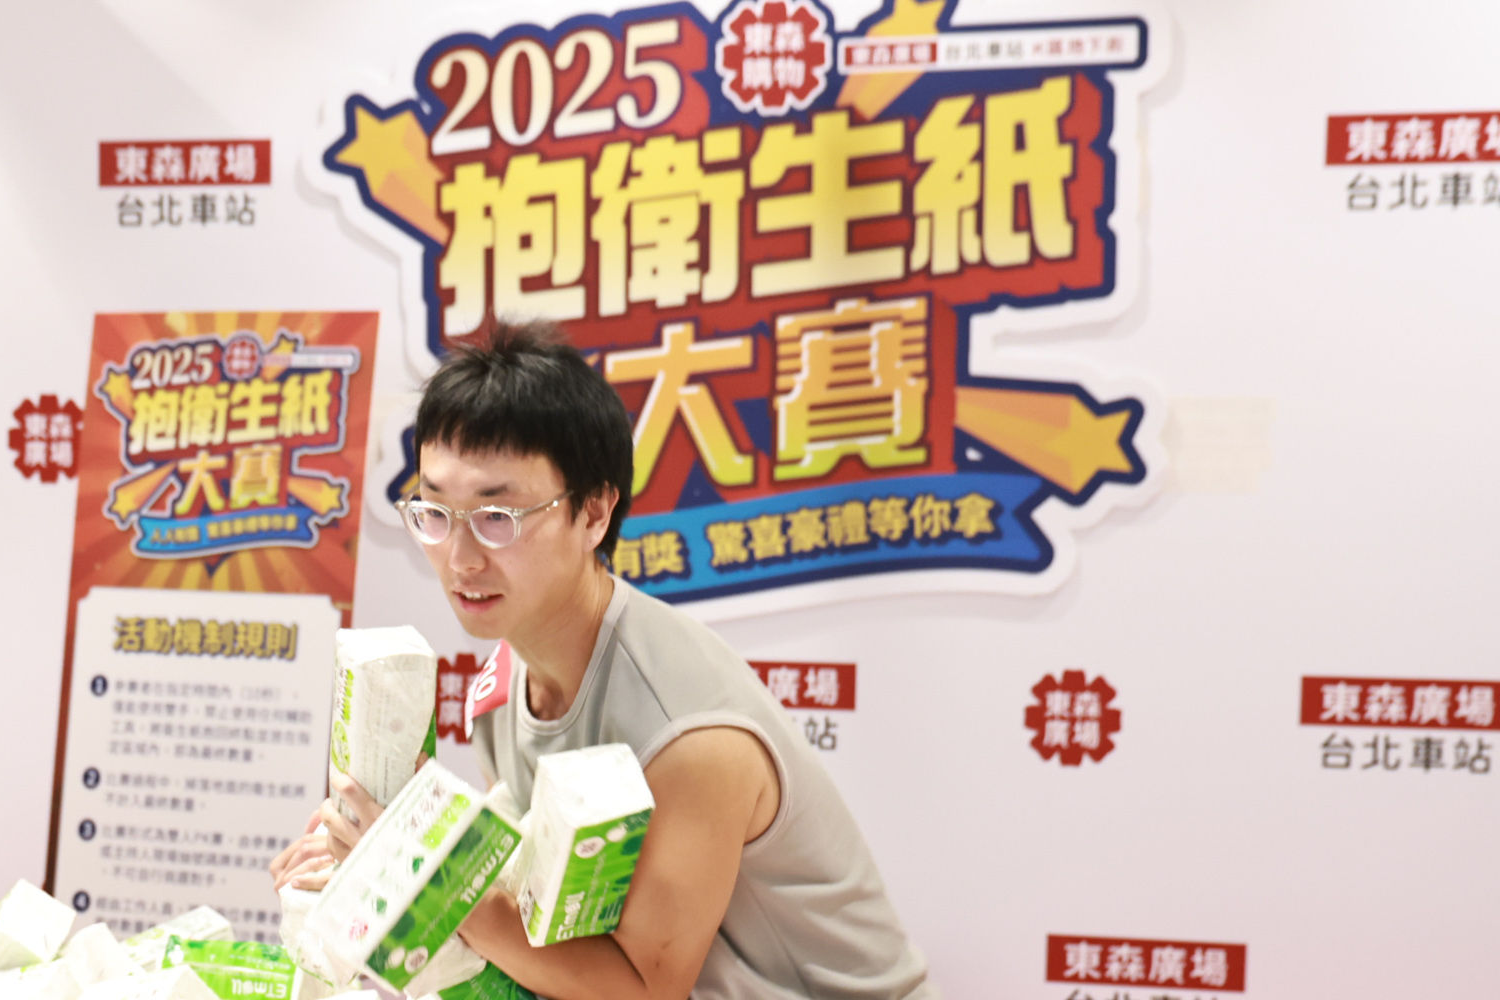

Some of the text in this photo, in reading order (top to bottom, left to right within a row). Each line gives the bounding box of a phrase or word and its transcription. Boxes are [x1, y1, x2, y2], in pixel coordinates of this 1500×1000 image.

[430, 17, 682, 154] 2025
[115, 144, 257, 183] 東森廣場
[118, 193, 256, 227] 台北車站
[440, 76, 1074, 336] 抱衛生紙
[132, 344, 214, 389] 2025
[129, 369, 333, 455] 抱衛生紙
[605, 295, 928, 496] 大賽
[707, 492, 996, 567] 驚喜豪禮等你拿
[753, 668, 840, 706] 廣場
[1045, 691, 1102, 717] 東森
[1320, 681, 1494, 726] 東森廣場
[1321, 732, 1493, 774] 台北車站
[1063, 941, 1228, 987] 東森廣場
[231, 978, 287, 999] ETmall
